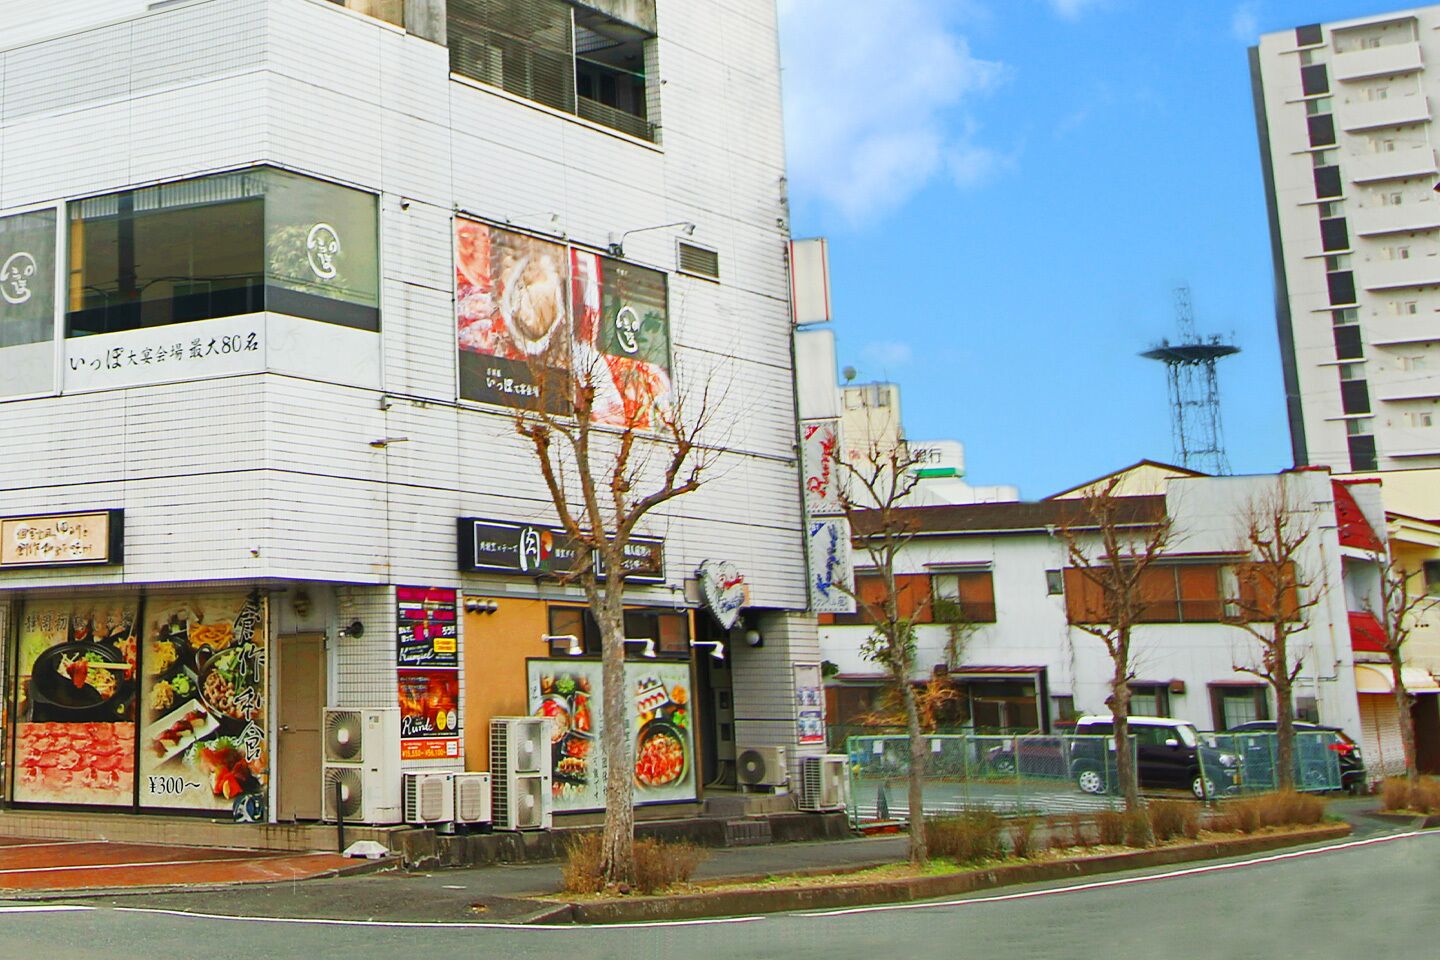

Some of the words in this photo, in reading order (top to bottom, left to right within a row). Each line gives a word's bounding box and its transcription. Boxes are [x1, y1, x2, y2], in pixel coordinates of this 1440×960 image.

[69, 343, 184, 371] いっぽ大宴会場
[189, 332, 258, 360] 最大80名
